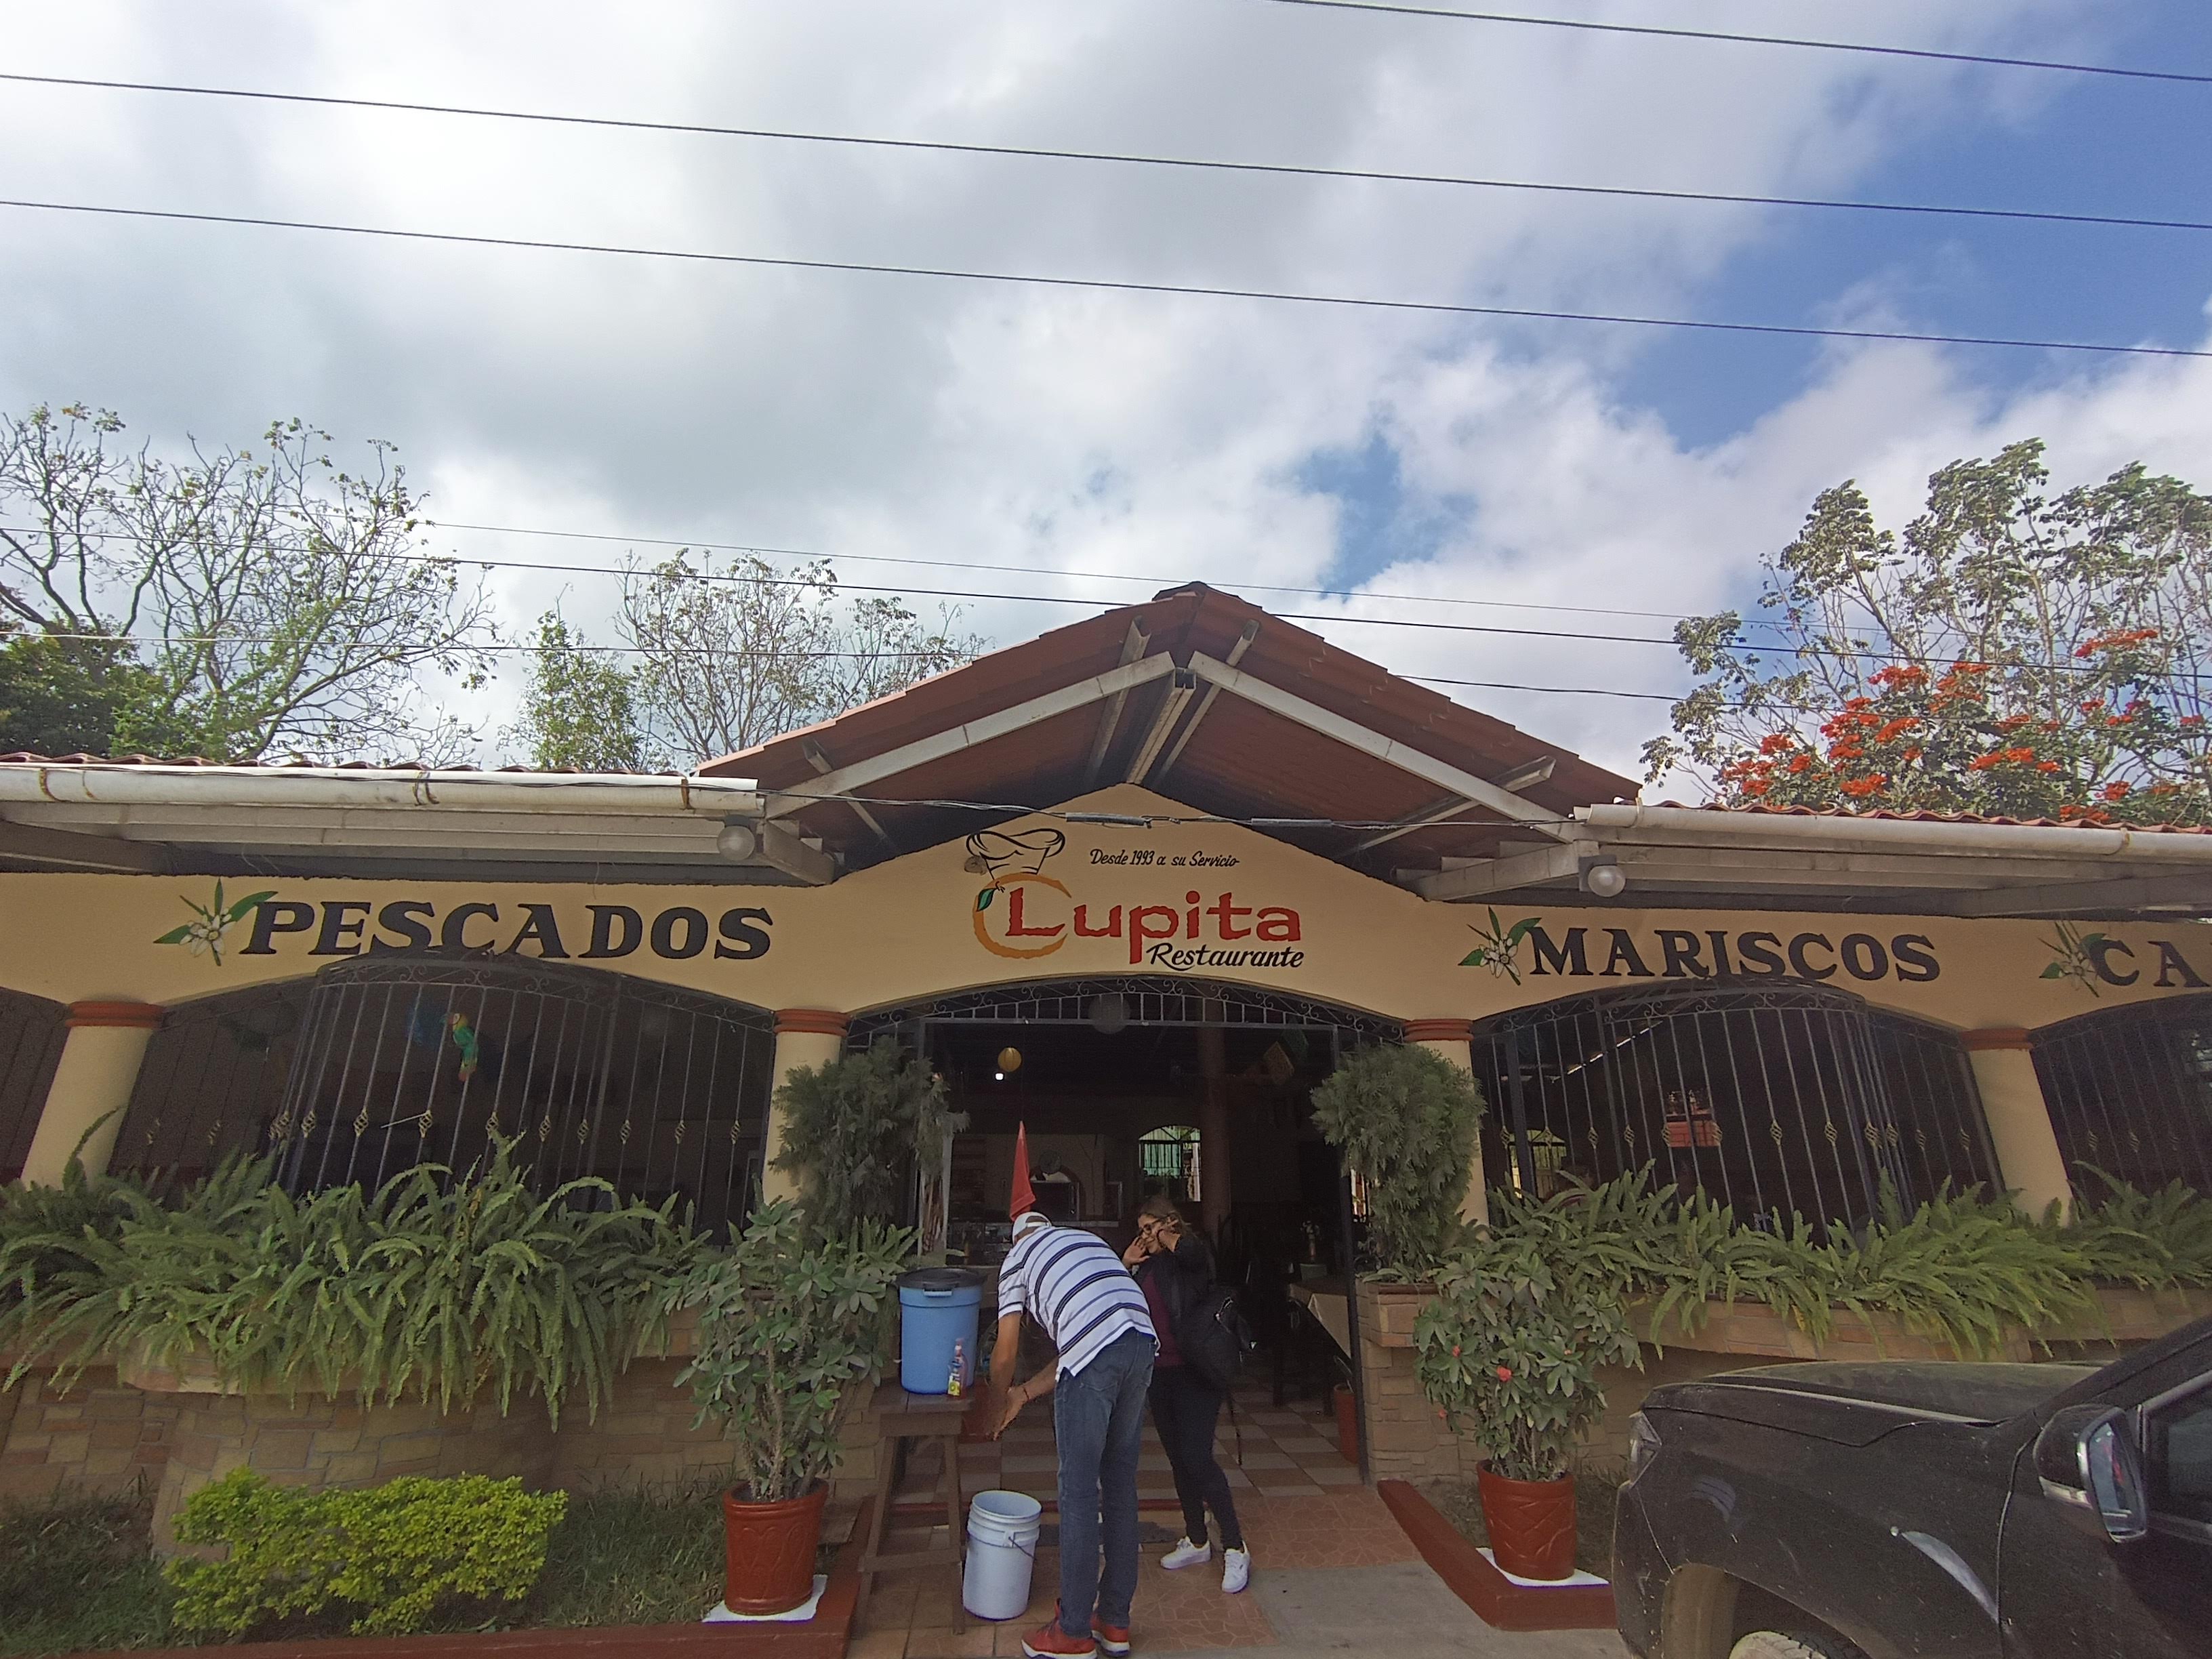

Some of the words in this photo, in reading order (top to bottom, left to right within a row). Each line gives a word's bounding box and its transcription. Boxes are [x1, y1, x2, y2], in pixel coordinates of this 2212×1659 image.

[1090, 848, 1128, 865] Desde
[1130, 850, 1155, 865] 1993
[1156, 856, 1166, 865] a
[1171, 856, 1186, 866] su
[1189, 851, 1240, 867] Servicio
[239, 901, 773, 960] PESCADOS
[1004, 887, 1301, 964] Lupita
[1146, 942, 1305, 971] Restaurante
[1524, 926, 1940, 982] MARISCOS
[2086, 939, 2212, 988] CA
